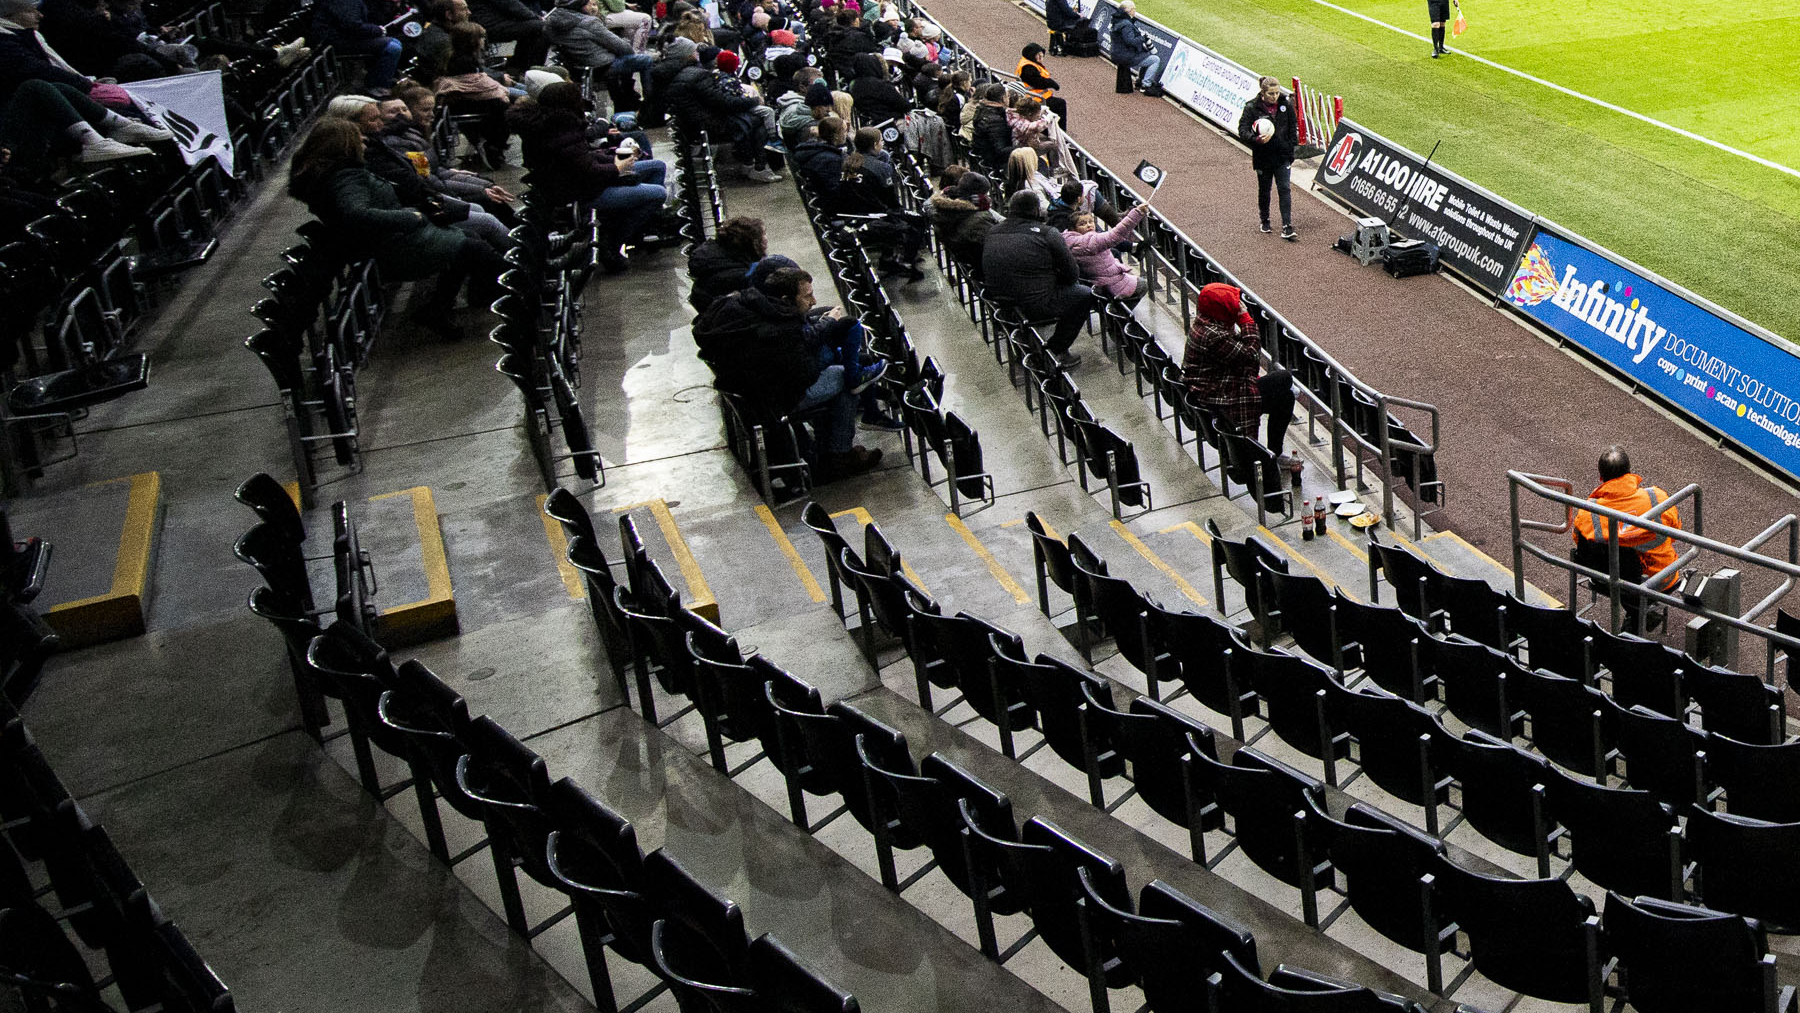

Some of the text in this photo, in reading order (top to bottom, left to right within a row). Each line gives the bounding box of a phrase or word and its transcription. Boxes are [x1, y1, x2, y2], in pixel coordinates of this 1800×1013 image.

[1202, 56, 1252, 91] Centres around you
[1351, 175, 1376, 201] 01656
[1373, 188, 1386, 205] 66
[1383, 194, 1398, 212] 55
[1359, 148, 1449, 212] A1 LOO HIRE
[1443, 207, 1515, 252] solutions throughout the UK
[1448, 194, 1519, 239] Mobile Toilet & Waste Water
[1409, 210, 1504, 279] www.a1groupuk.com
[1551, 264, 1667, 365] Infinity
[1664, 332, 1741, 389] DOCUMENT
[1657, 356, 1677, 377] copy
[1683, 371, 1708, 394] print
[1714, 392, 1737, 411] scan
